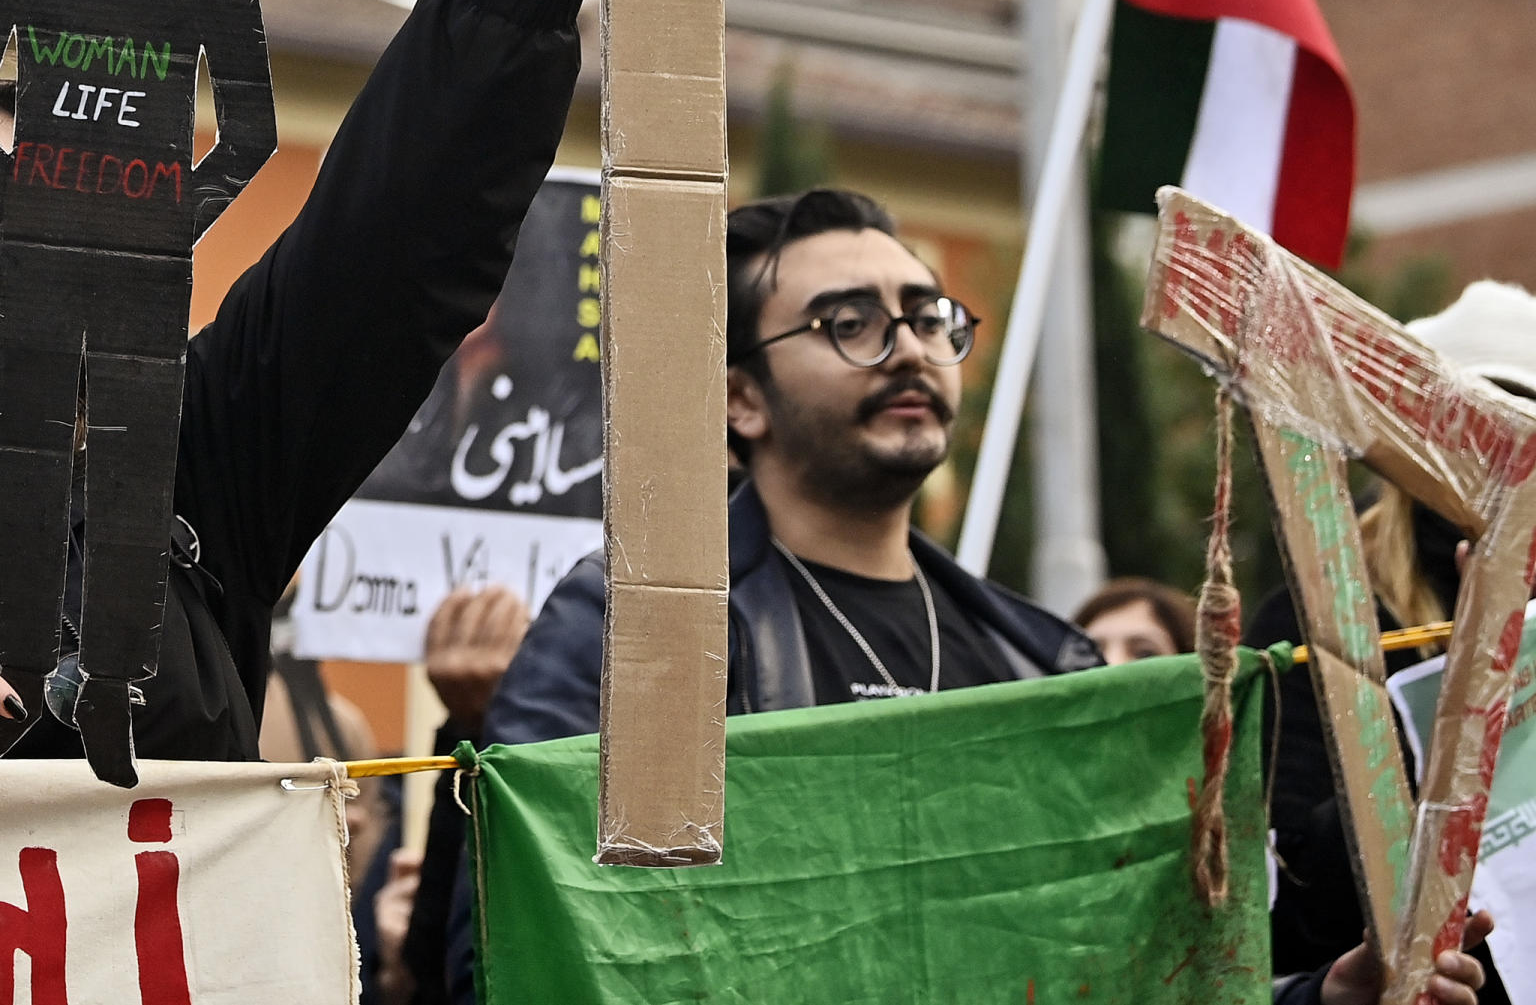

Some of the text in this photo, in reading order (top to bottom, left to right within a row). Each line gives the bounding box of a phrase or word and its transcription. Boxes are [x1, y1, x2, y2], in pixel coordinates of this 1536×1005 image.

[27, 24, 171, 82] WOMAN
[51, 81, 147, 128] LIFE
[14, 141, 182, 204] FREEDOM
[313, 523, 420, 616] Donna
